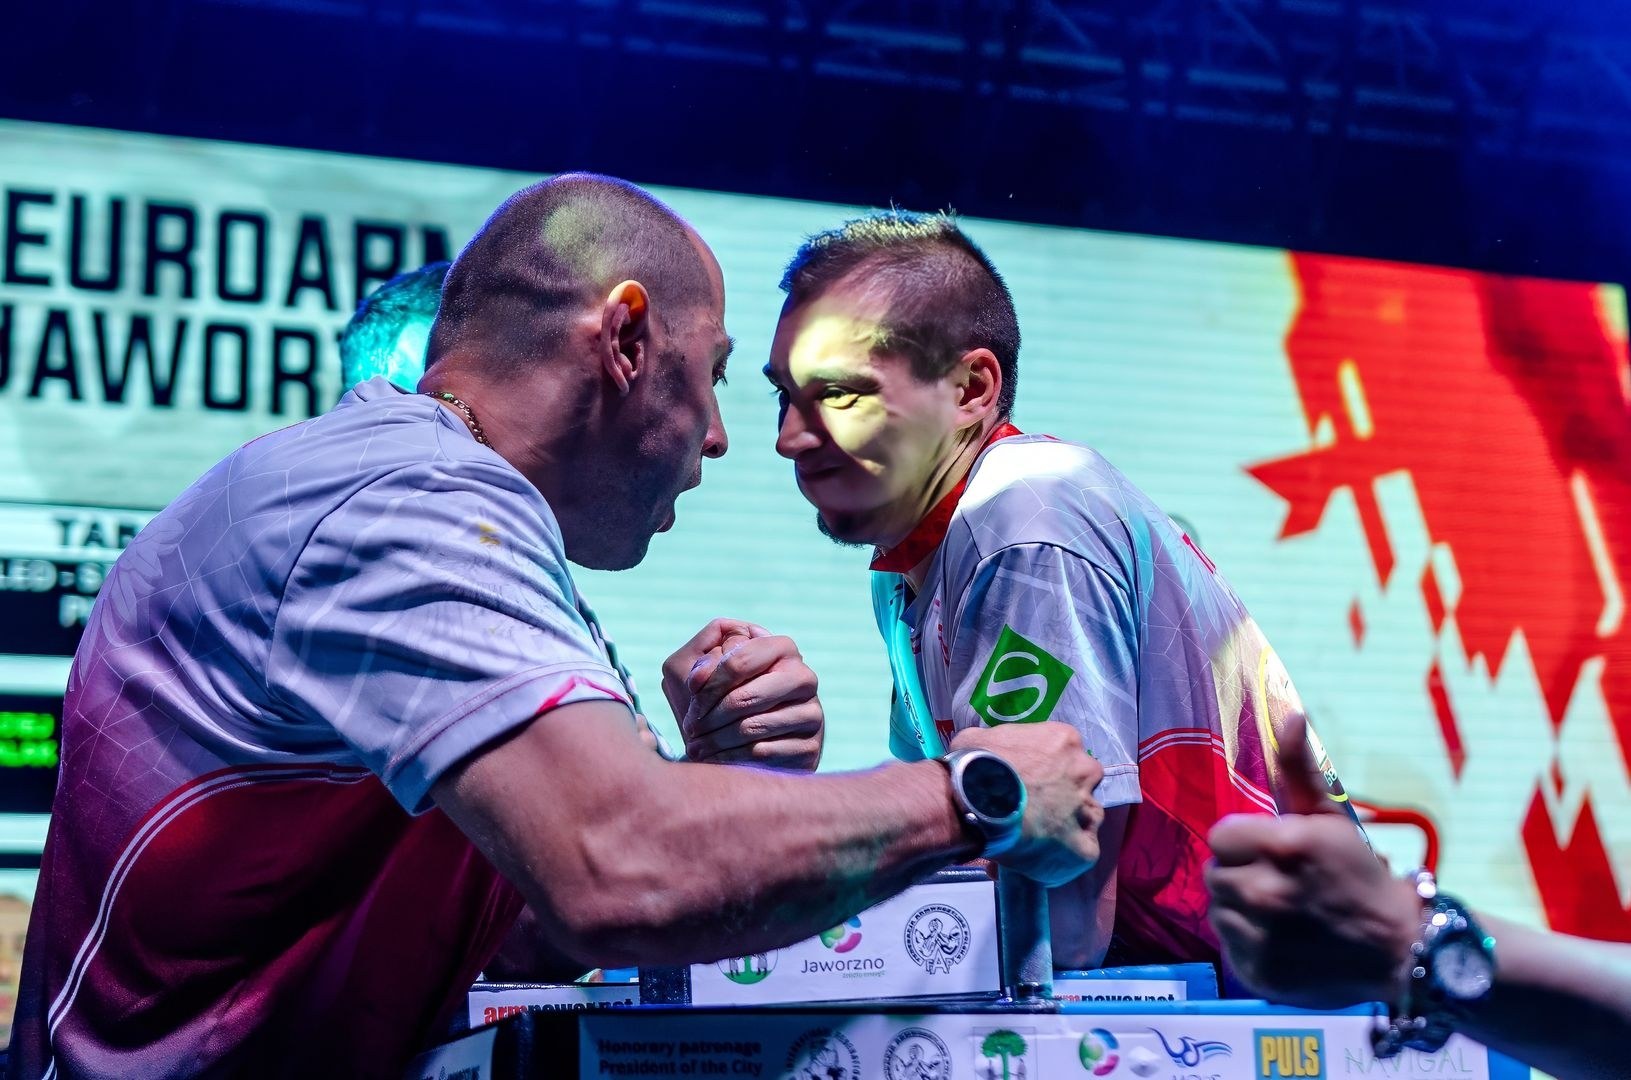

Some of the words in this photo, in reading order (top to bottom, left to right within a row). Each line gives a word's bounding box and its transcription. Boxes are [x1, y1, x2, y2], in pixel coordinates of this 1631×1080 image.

[800, 957, 885, 974] Jaworzno
[599, 1038, 675, 1057] Honorary
[680, 1040, 763, 1058] patronage
[1262, 1036, 1320, 1077] PULS
[599, 1059, 677, 1076] President
[680, 1059, 698, 1076] of
[701, 1059, 728, 1075] the
[731, 1059, 763, 1078] City
